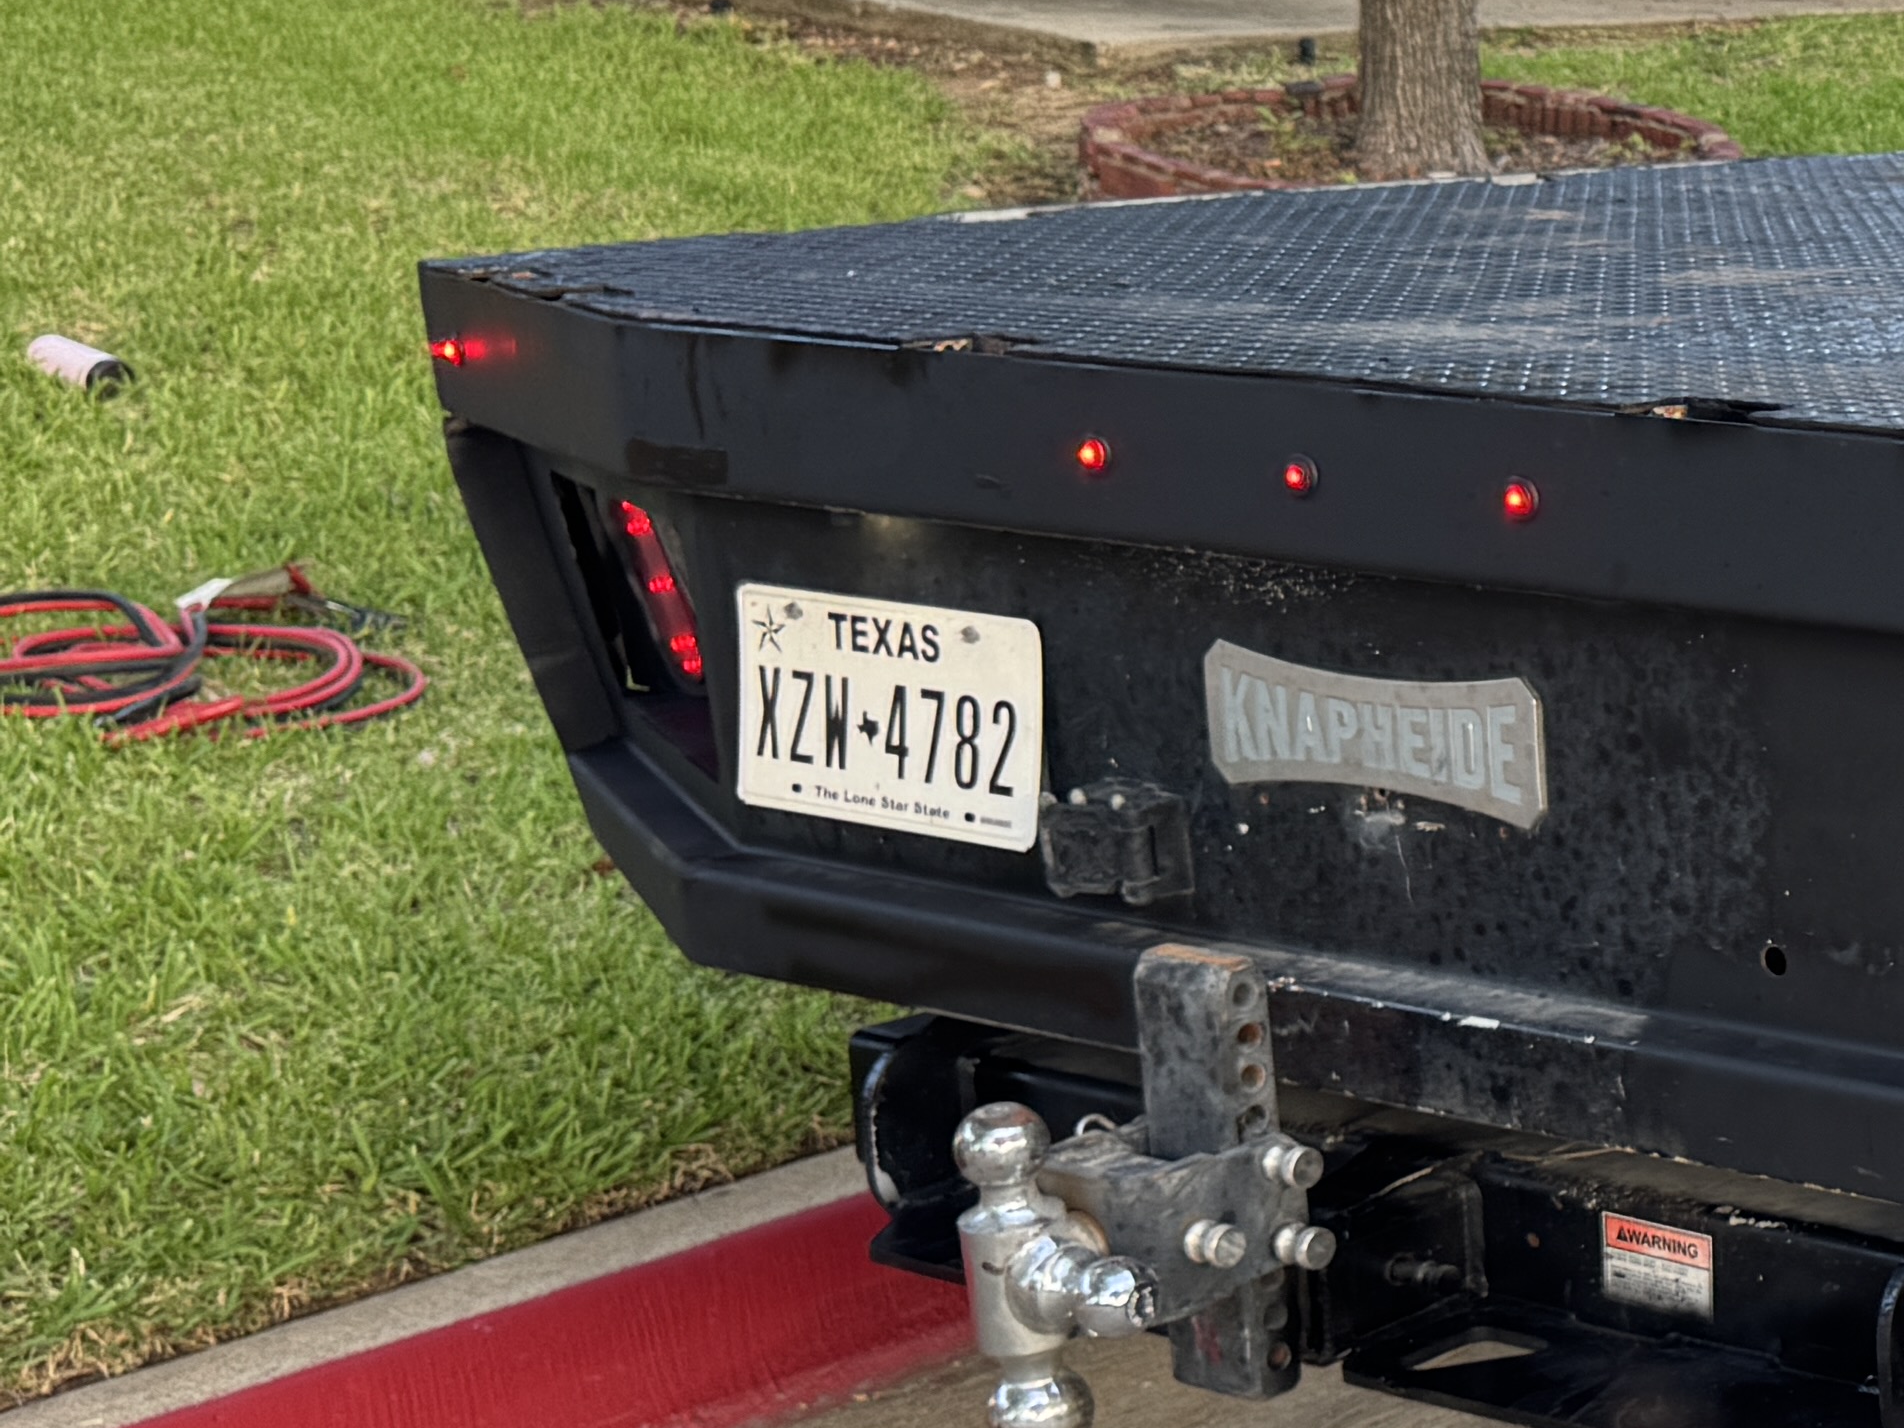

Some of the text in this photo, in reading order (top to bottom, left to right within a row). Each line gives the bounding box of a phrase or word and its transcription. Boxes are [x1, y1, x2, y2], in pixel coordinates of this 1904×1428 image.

[827, 612, 940, 663] TEXAS
[756, 665, 1017, 798] XZW 4782
[1219, 665, 1522, 805] KNAPHEIDE
[815, 784, 950, 820] The Lone Star State
[1627, 1227, 1699, 1259] WARNING
